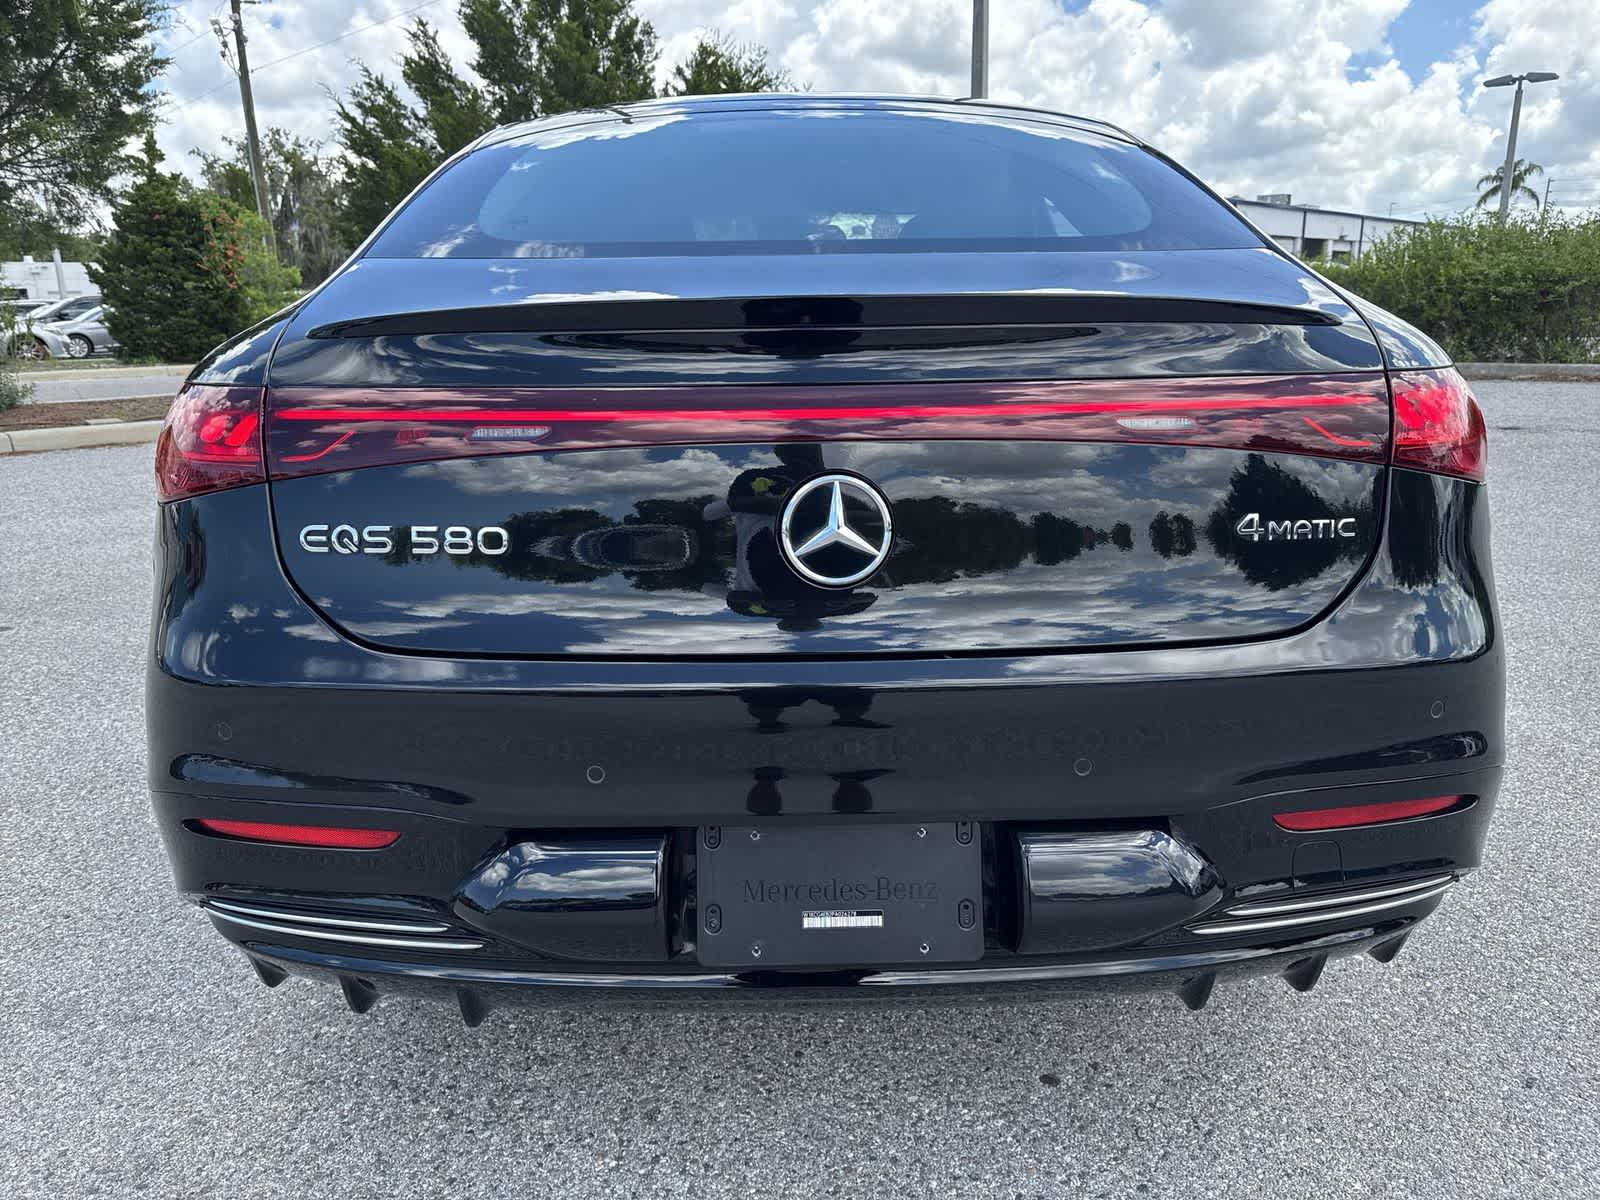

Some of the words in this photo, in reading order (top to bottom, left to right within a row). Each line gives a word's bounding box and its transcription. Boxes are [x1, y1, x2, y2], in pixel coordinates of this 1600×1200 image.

[300, 524, 393, 554] EQS
[411, 526, 509, 555] 580
[743, 876, 938, 902] Mercedes-Benz
